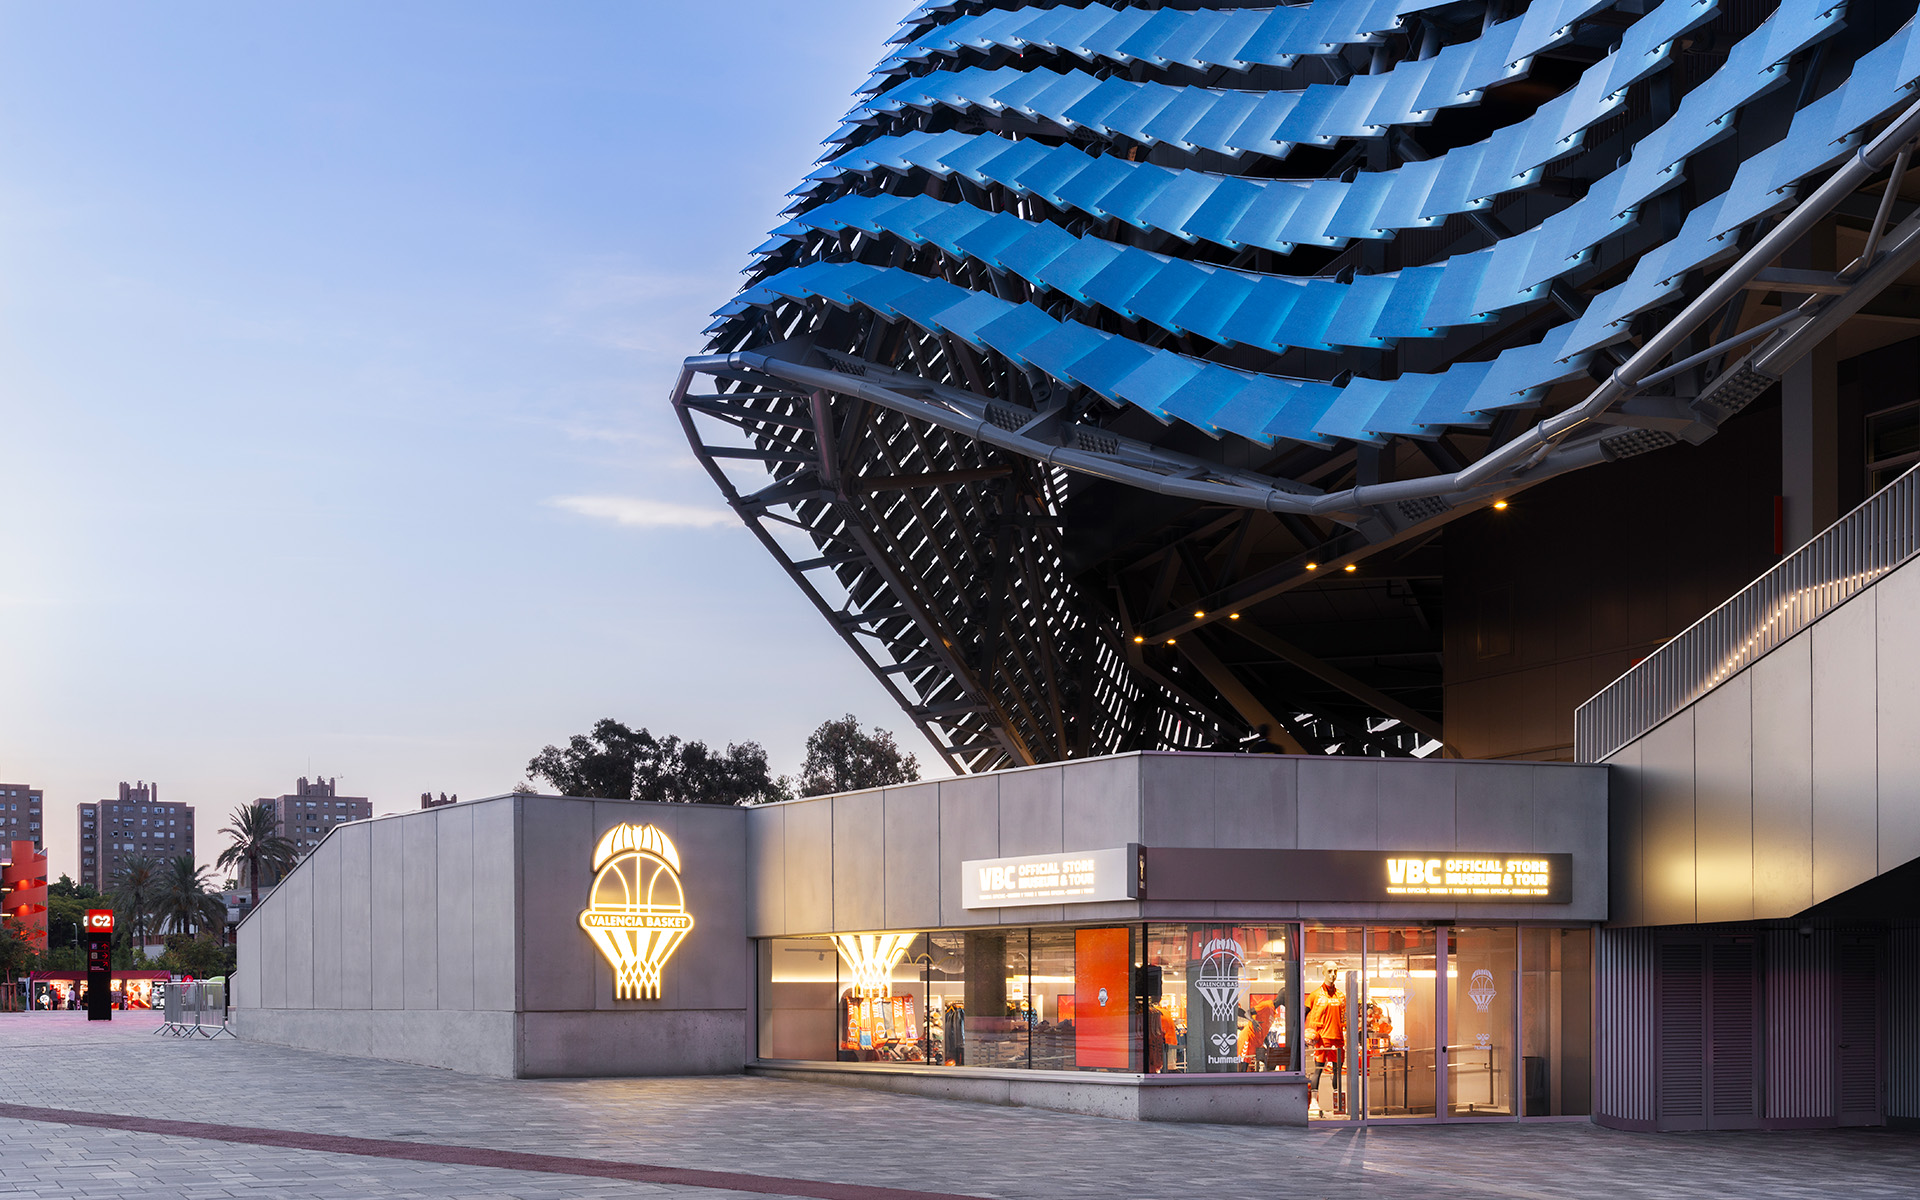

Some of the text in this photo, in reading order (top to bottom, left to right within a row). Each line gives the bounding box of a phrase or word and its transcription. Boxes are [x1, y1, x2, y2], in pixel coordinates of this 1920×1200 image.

[1018, 860, 1094, 876] OFFICIAL STORE
[1387, 859, 1441, 884] VBC
[1446, 860, 1548, 873] OFFICIAL STORE
[979, 866, 1015, 891] VBC
[1018, 873, 1095, 889] MUSEUM & TOUR
[1445, 873, 1548, 886] MUSEUM & TOUR
[92, 915, 111, 926] C2
[590, 916, 687, 928] VALENCIA BASKET
[1208, 1055, 1241, 1064] hummel
